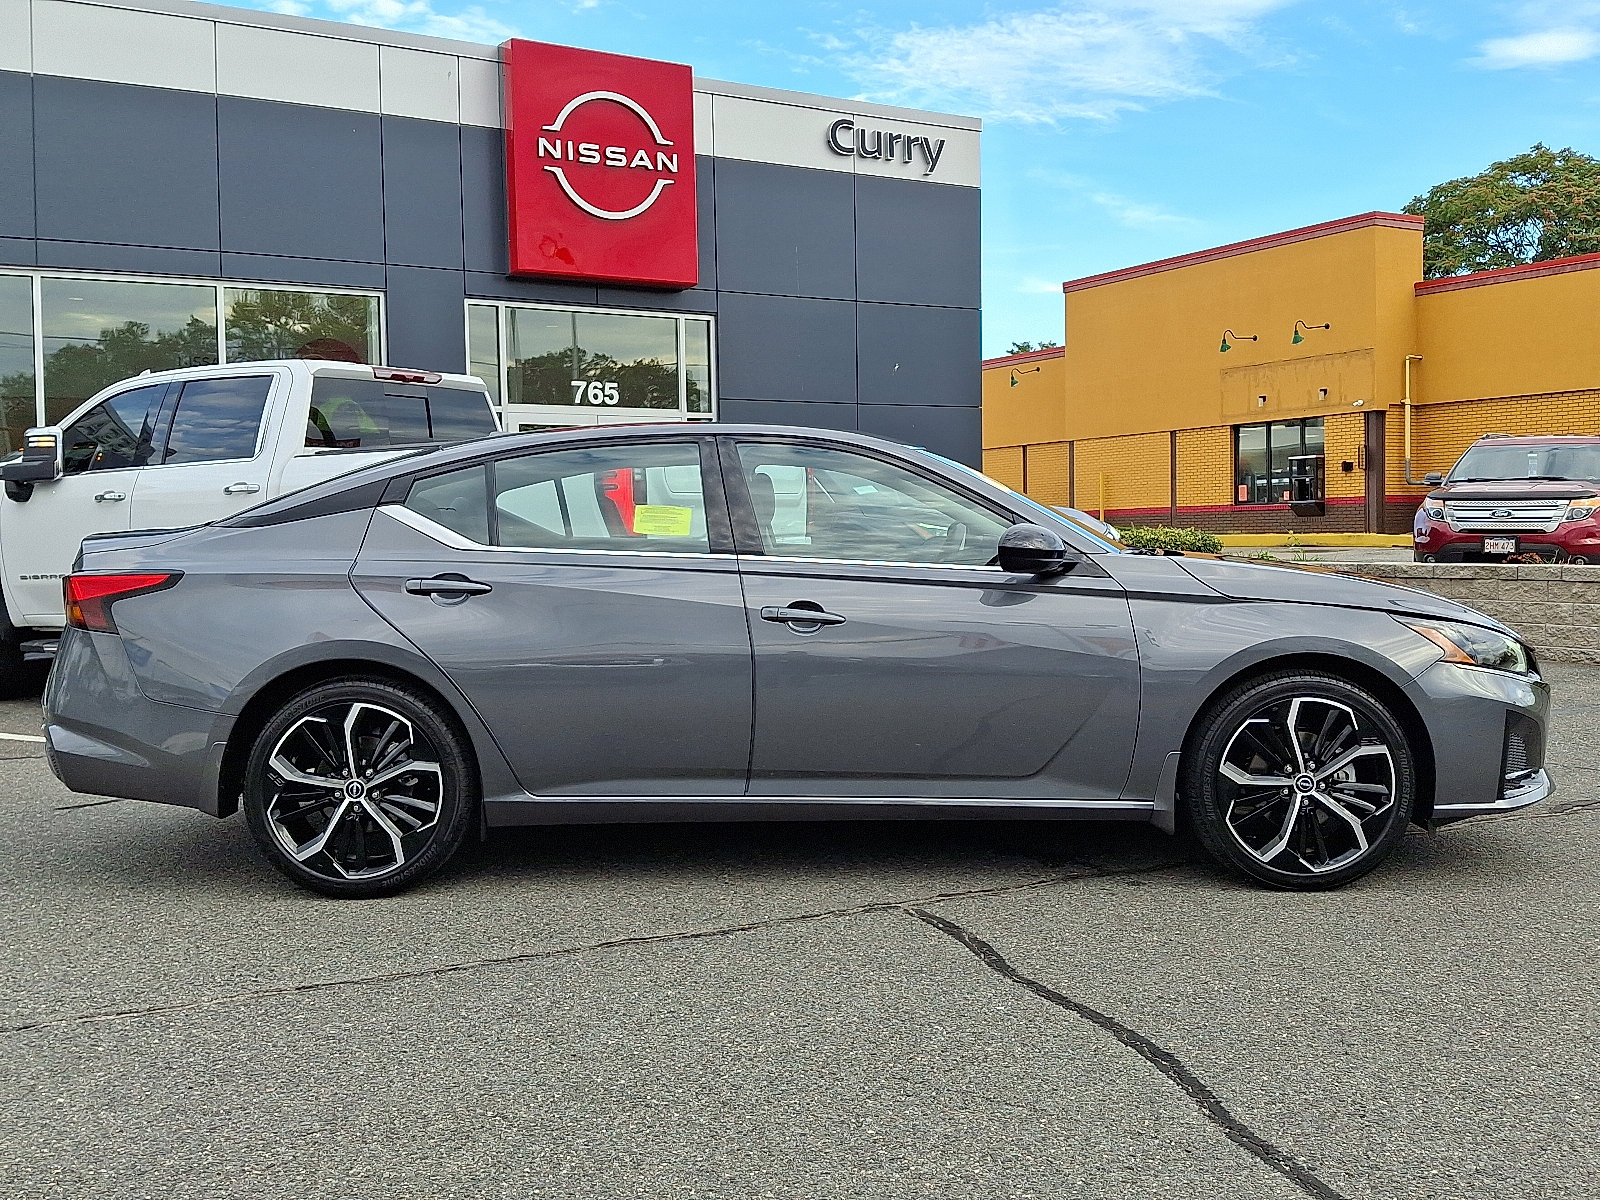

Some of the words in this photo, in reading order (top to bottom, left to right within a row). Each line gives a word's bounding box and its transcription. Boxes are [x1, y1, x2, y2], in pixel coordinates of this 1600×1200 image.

[538, 136, 679, 173] NISSAN
[826, 118, 946, 176] Curry
[570, 380, 620, 405] 765
